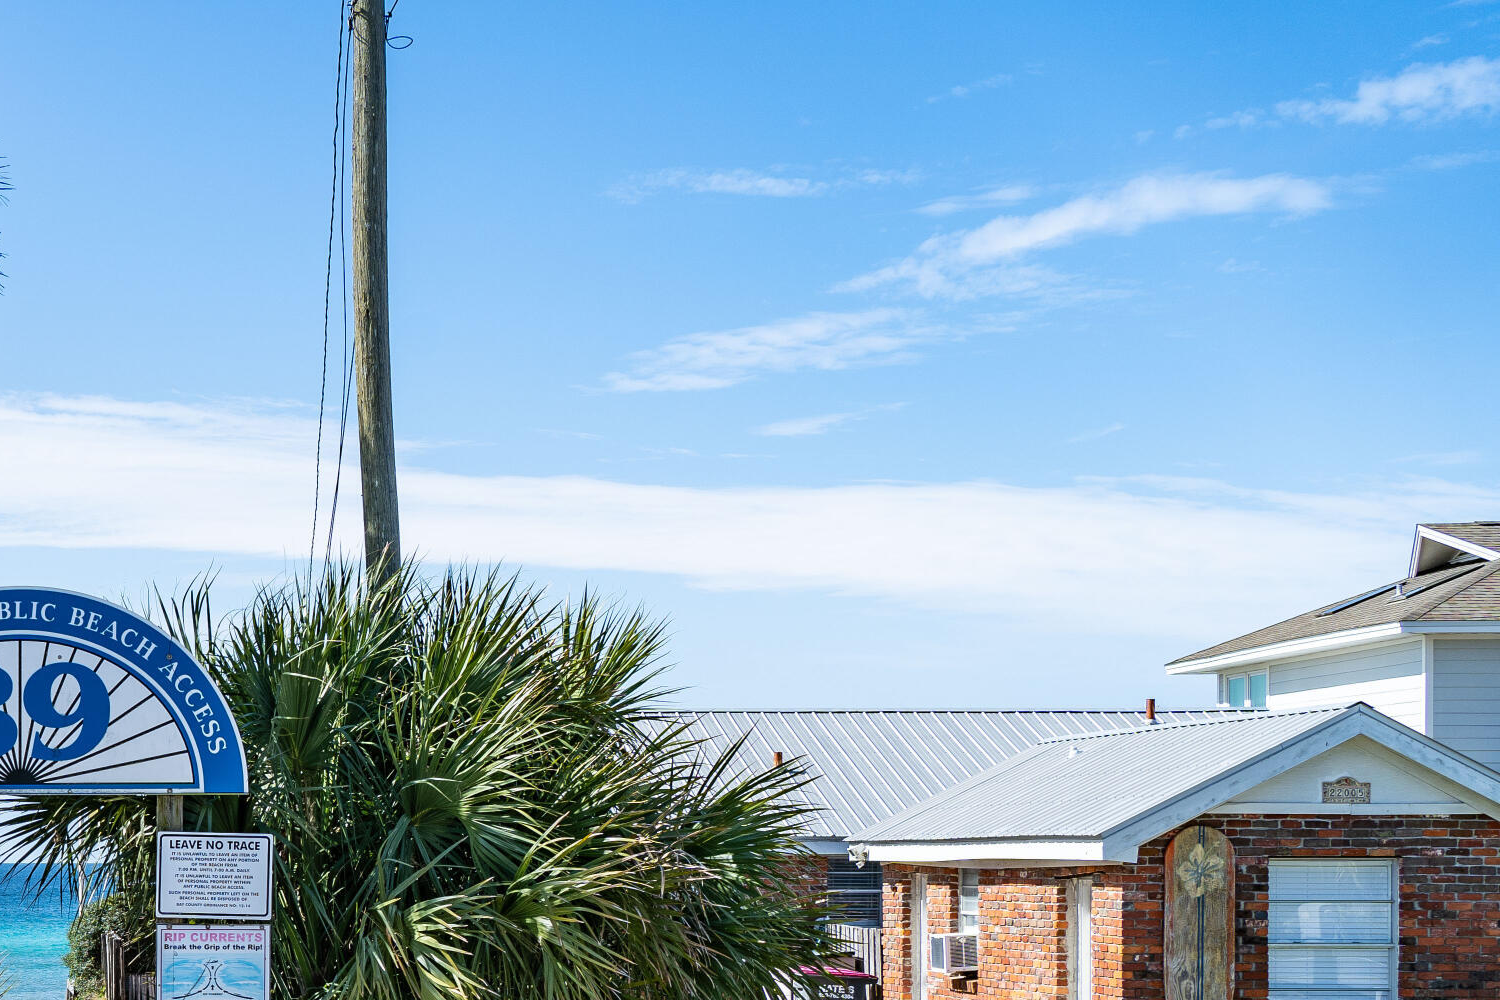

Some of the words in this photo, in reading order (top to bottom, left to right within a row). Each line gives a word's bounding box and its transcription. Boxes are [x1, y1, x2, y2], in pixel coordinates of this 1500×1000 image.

[68, 607, 158, 661] BEACH
[158, 659, 227, 755] ACCESS
[1329, 788, 1364, 797] 22005
[170, 840, 203, 849] LEAVE
[205, 840, 224, 850] NO
[227, 841, 260, 850] TRACE
[165, 933, 186, 942] RIP
[190, 933, 262, 942] CURRENTS
